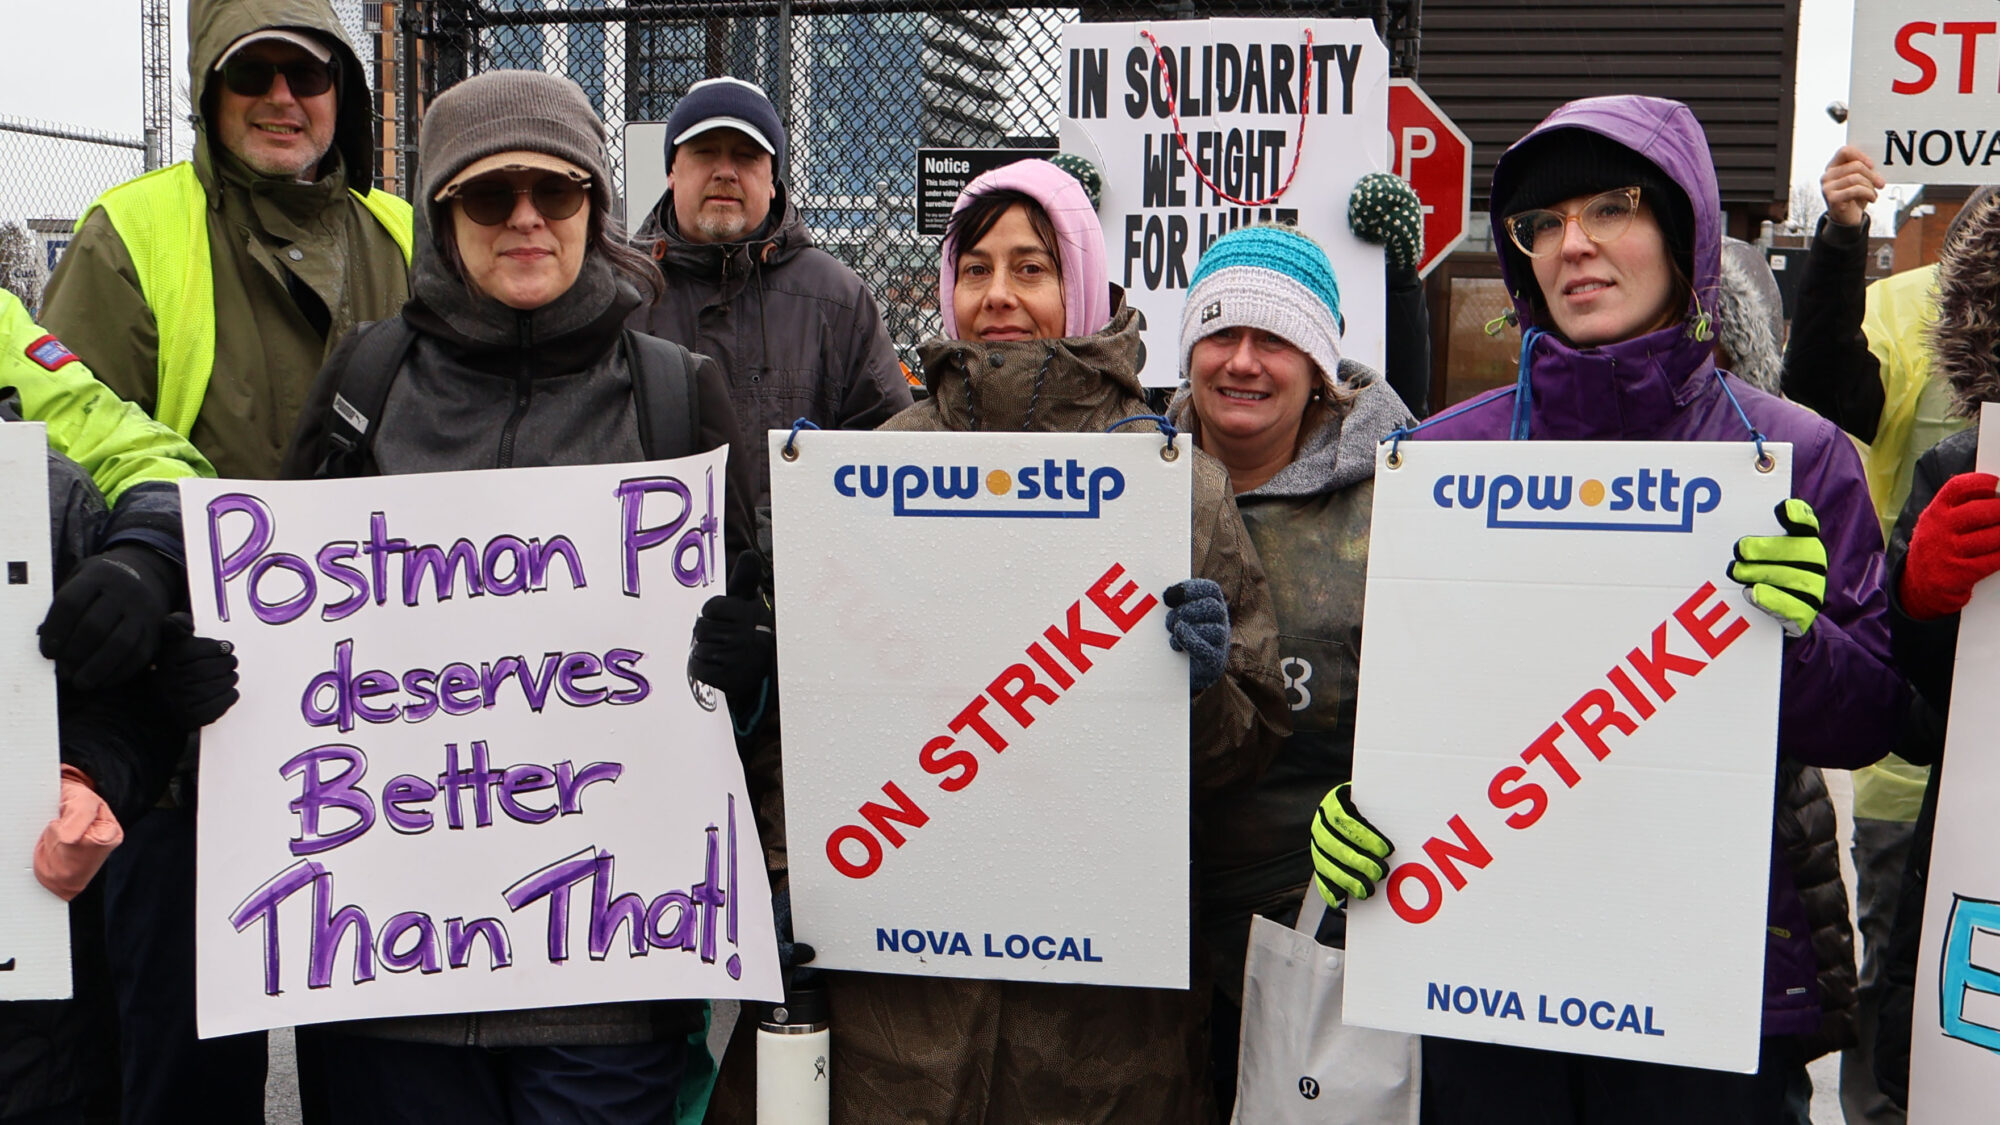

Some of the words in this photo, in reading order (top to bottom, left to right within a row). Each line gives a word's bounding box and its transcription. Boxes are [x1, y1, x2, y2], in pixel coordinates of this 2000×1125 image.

[1069, 48, 1108, 119] IN
[1125, 43, 1363, 119] SOLIDARITY
[1892, 21, 2000, 95] ST
[925, 157, 970, 174] Notice
[925, 179, 938, 187] This
[939, 179, 959, 188] facility
[1143, 133, 1188, 208] WE
[1195, 127, 1286, 207] FIGHT
[1124, 214, 1190, 291] FOR
[206, 492, 588, 626] Postman
[612, 464, 718, 599] Pat
[300, 638, 656, 734] deserves
[826, 780, 930, 879] ON
[919, 562, 1159, 794] STRIKE
[1387, 814, 1495, 924] ON
[1488, 581, 1751, 831] STRIKE
[279, 740, 625, 857] Better
[228, 858, 513, 997] Than
[502, 791, 743, 982] That!
[876, 928, 972, 956] NOVA
[984, 932, 1102, 962] LOCAL
[1427, 982, 1525, 1021] NOVA
[1538, 994, 1666, 1036] LOCAL
